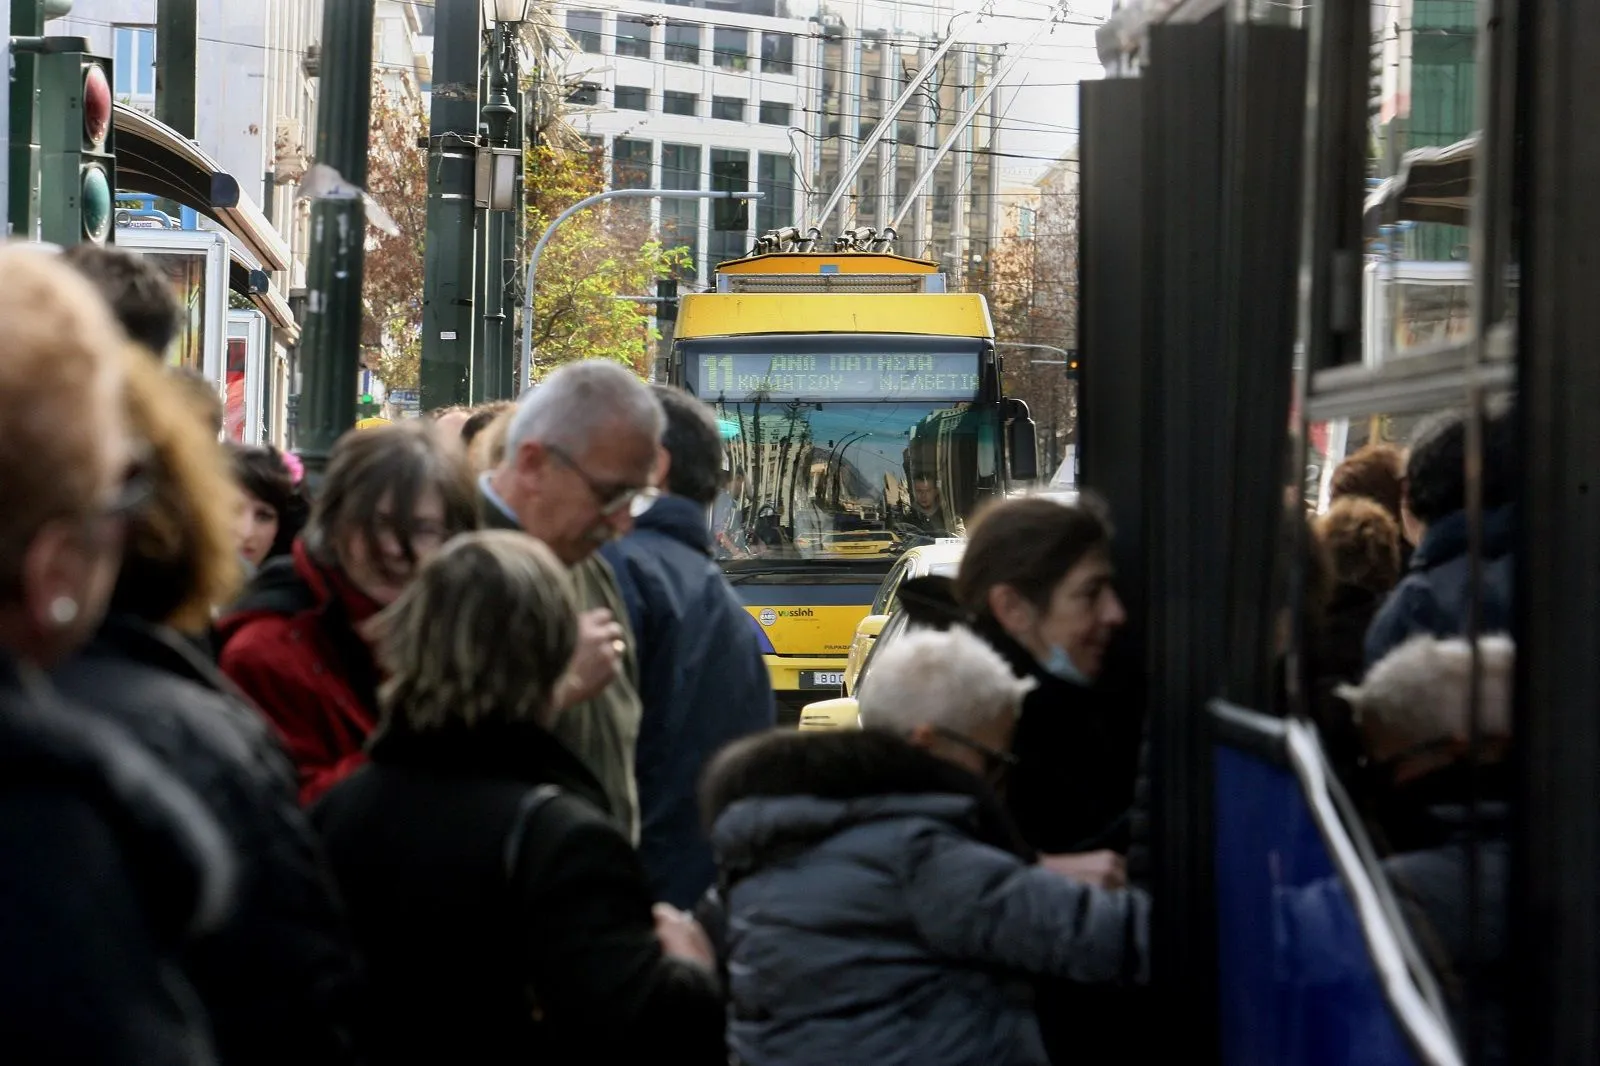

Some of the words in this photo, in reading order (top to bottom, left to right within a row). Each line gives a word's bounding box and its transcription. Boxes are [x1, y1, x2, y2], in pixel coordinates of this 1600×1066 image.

[702, 355, 733, 391] 11
[771, 355, 815, 370] ΑΝΩ
[831, 355, 934, 370] ΠΑΤΗΣΙΑ
